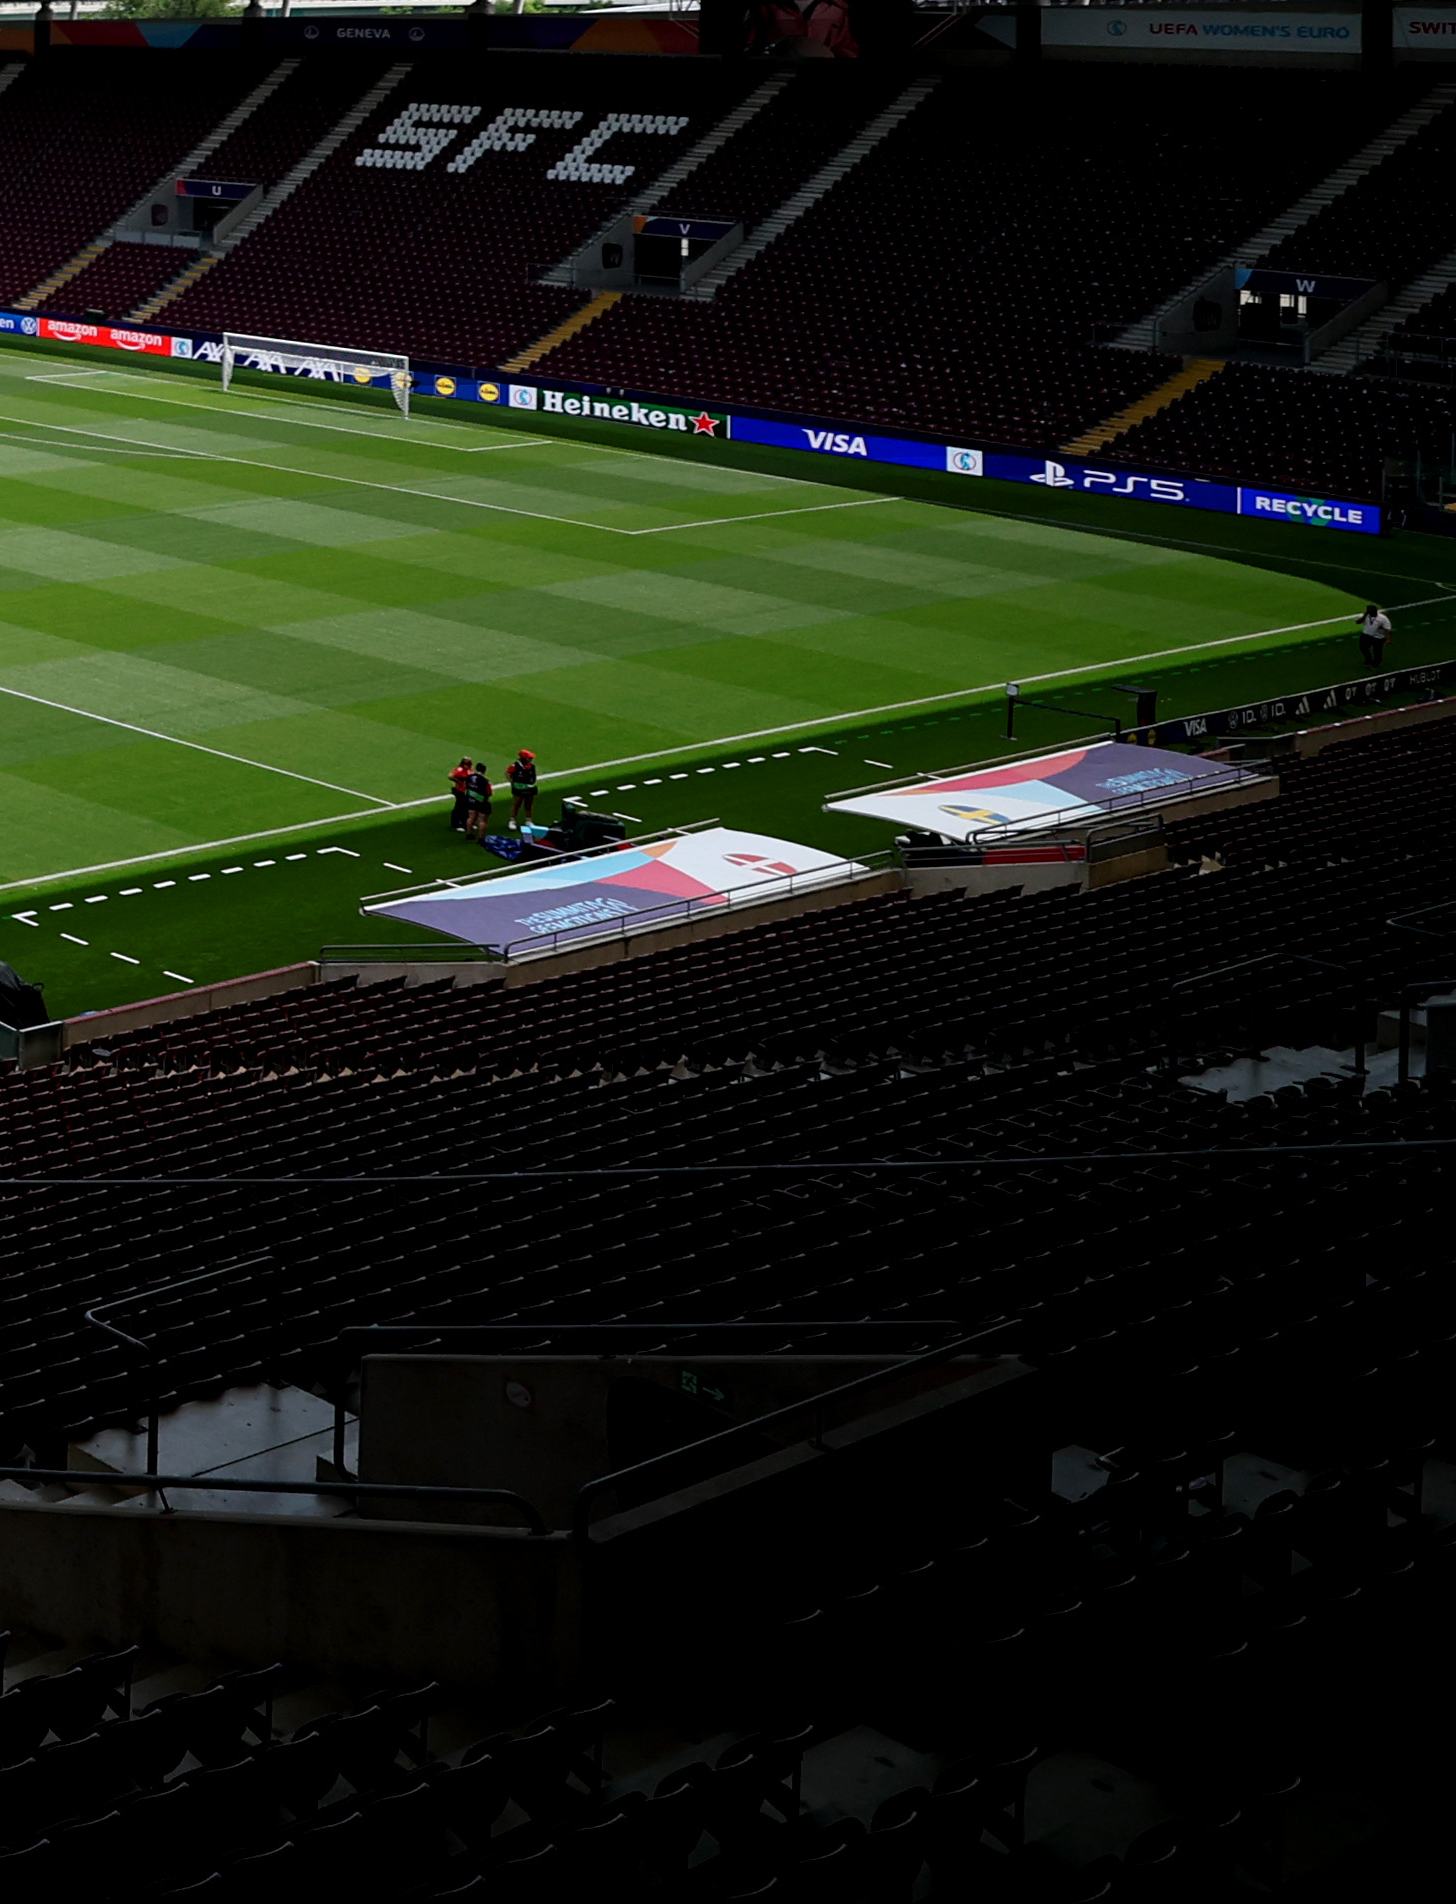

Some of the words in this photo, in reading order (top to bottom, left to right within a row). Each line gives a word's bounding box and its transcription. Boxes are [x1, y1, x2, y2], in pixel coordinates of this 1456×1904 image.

[336, 28, 391, 39] GENEVA
[1149, 22, 1198, 35] UEFA
[1202, 24, 1291, 37] WOMEN'S
[1298, 26, 1350, 38] EURO
[212, 185, 222, 196] U
[679, 223, 691, 234] V
[1296, 278, 1317, 293] W
[48, 320, 98, 338] amazon
[110, 328, 162, 346] amazon
[543, 388, 688, 432] Heineken
[802, 428, 868, 456] VISA
[1083, 469, 1185, 501] PS5
[1255, 495, 1363, 524] RECYCLE
[1182, 718, 1208, 737] VISA
